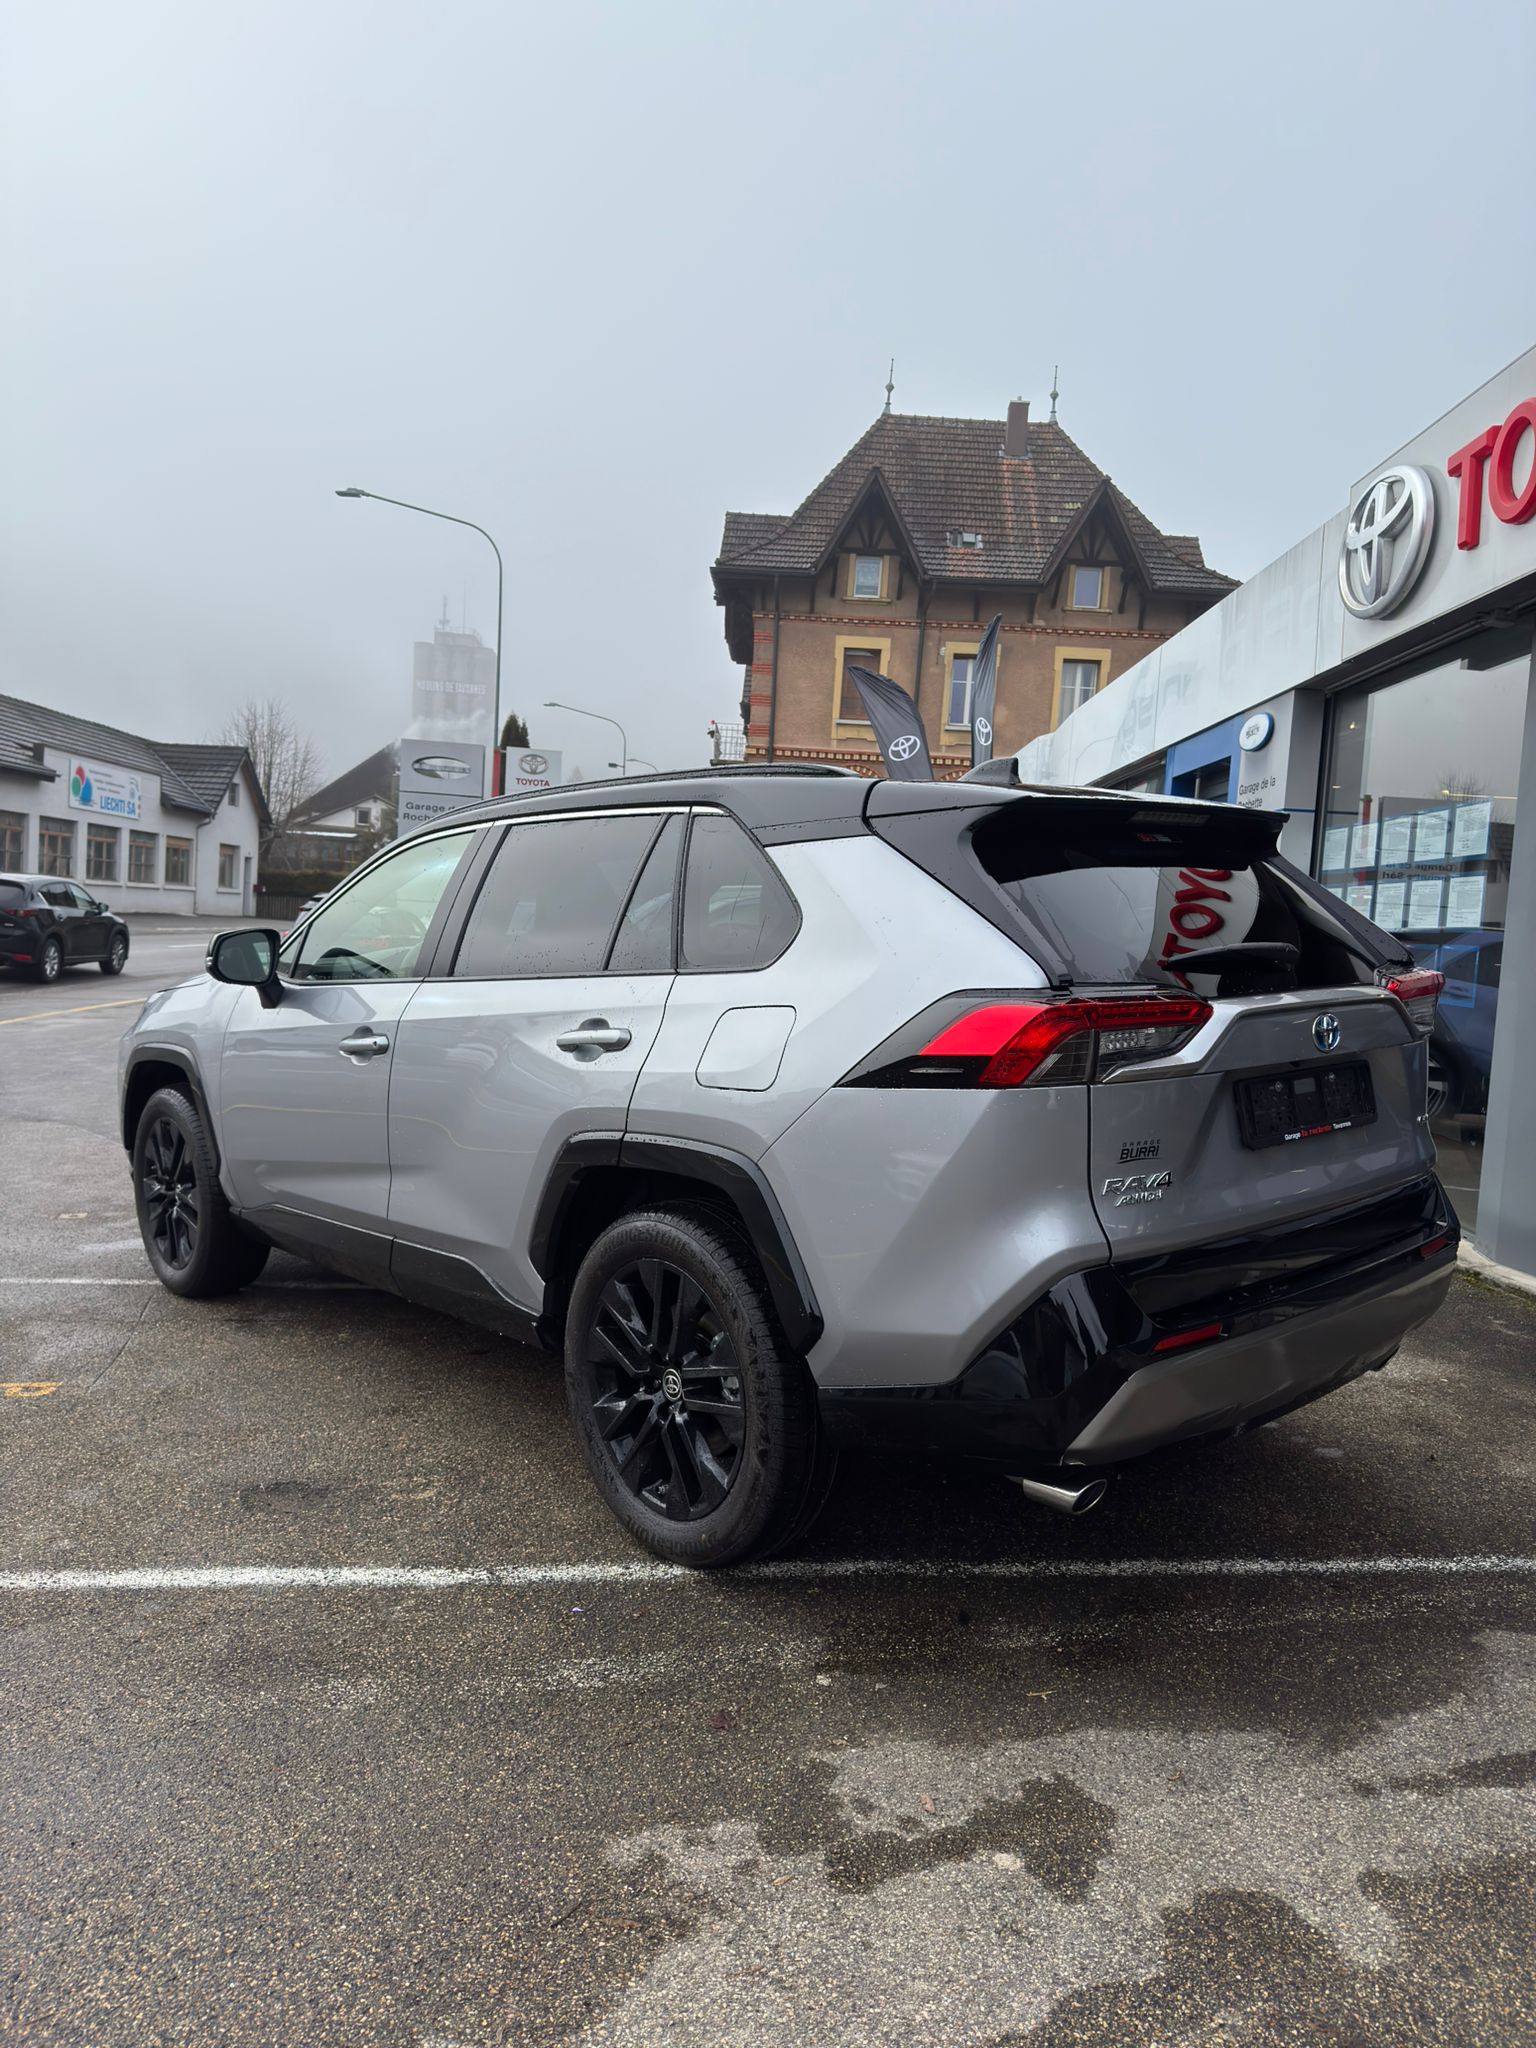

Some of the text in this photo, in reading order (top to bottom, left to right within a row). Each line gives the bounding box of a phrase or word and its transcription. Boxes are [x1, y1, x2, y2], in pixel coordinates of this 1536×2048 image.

[1448, 397, 1536, 550] TO
[516, 777, 551, 787] TOYOTA
[1239, 776, 1276, 795] Garage de la
[100, 796, 135, 816] LIECHTI SA
[405, 802, 445, 812] Garage
[1122, 1139, 1160, 1148] GARAGE
[1119, 1145, 1160, 1160] BURRI
[1102, 1170, 1172, 1196] RAV4
